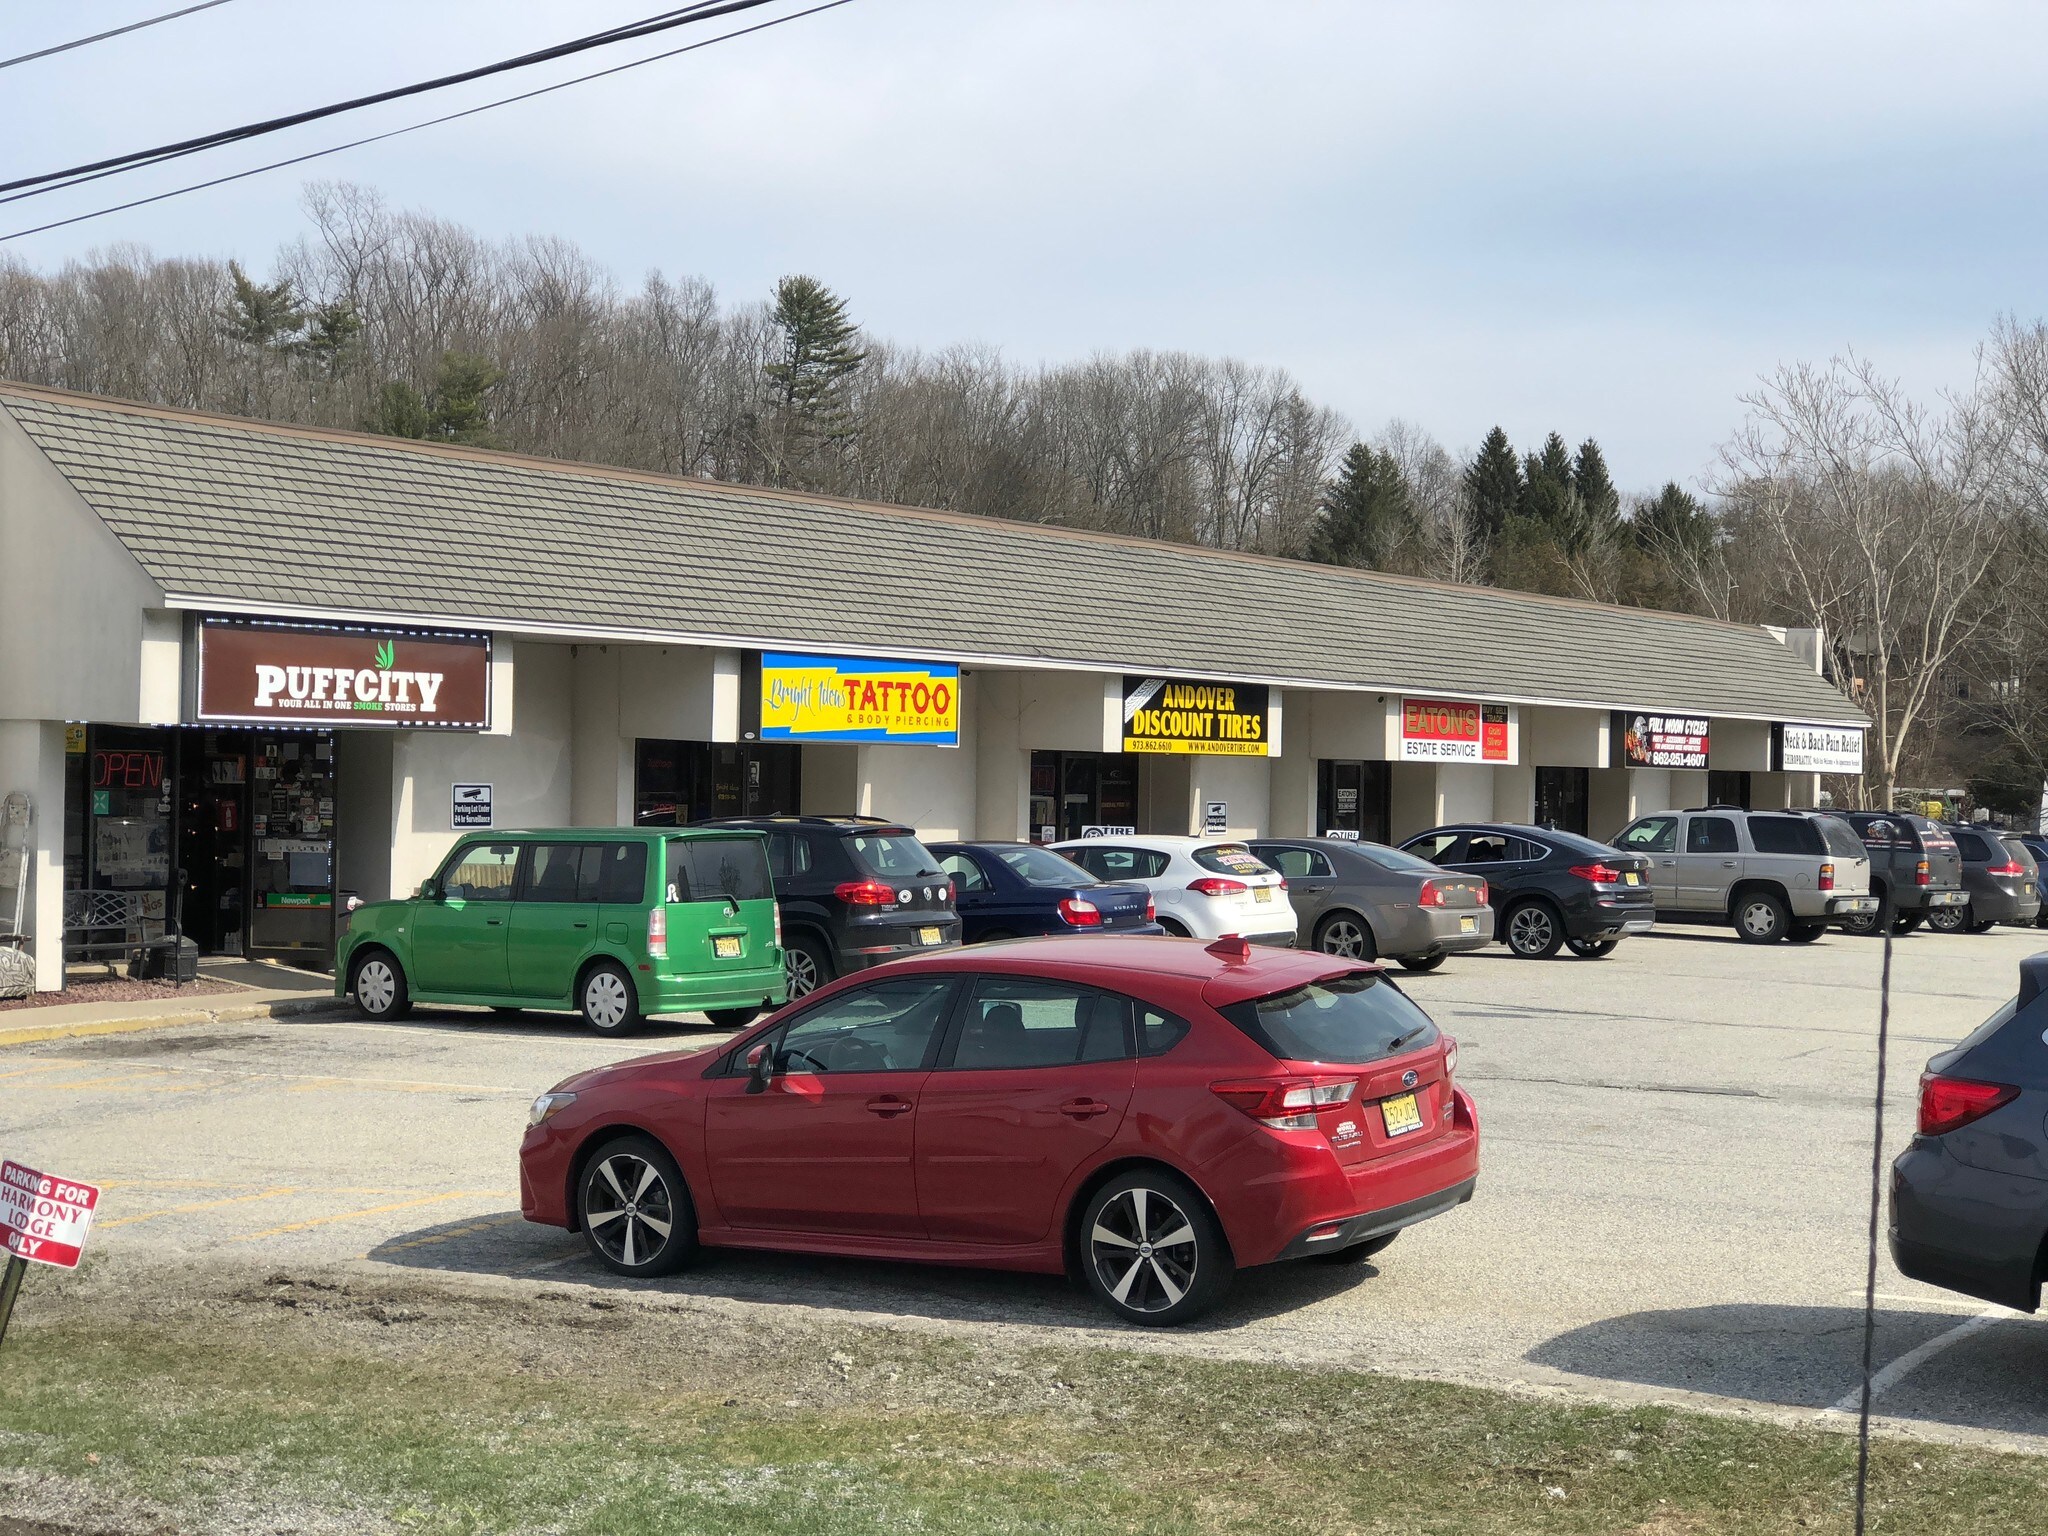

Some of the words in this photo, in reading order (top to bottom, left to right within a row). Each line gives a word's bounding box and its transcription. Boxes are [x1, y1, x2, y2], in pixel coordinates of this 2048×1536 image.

[254, 665, 443, 712] PUFFCITY
[764, 677, 817, 721] Bright
[818, 677, 845, 711] Ideas
[844, 679, 951, 714] TATTOO
[1163, 684, 1235, 711] ANDOVER
[278, 698, 302, 708] YOUR
[304, 700, 321, 709] ALL
[323, 701, 333, 710] IN
[334, 702, 352, 710] ONE
[353, 702, 383, 711] SMOKE
[384, 703, 416, 712] STORES
[847, 714, 853, 723] &
[859, 715, 890, 724] BODY
[896, 716, 949, 727] PIERCING
[1133, 710, 1213, 737] DISCOUNT
[1218, 714, 1261, 740] TIRES
[1406, 706, 1477, 736] EATON'S
[1648, 717, 1663, 733] FULL
[1664, 718, 1685, 734] MOON
[1685, 719, 1708, 736] CYCLES
[1132, 740, 1172, 751] 973.862.6610
[1188, 742, 1260, 753] WWW.ANDOVERTIRE.COM
[1407, 742, 1437, 755] ESTATE
[1440, 743, 1476, 757] SERVICE
[1784, 731, 1800, 749] Neck
[1802, 733, 1807, 750] &
[1808, 733, 1825, 751] Back
[1826, 734, 1840, 752] Pain
[1841, 735, 1860, 753] Relief
[94, 753, 159, 788] OPEN
[1653, 752, 1706, 766] 862-251-4607
[454, 805, 471, 814] Parking
[1102, 827, 1133, 836] TIRE
[1340, 831, 1358, 839] TIRE
[281, 896, 311, 905] Newport
[4, 1165, 52, 1195] PARKING
[54, 1183, 90, 1205] FOR
[1, 1186, 82, 1224] HARMONY
[8, 1208, 55, 1238] LODGE
[8, 1231, 43, 1255] ONLY
